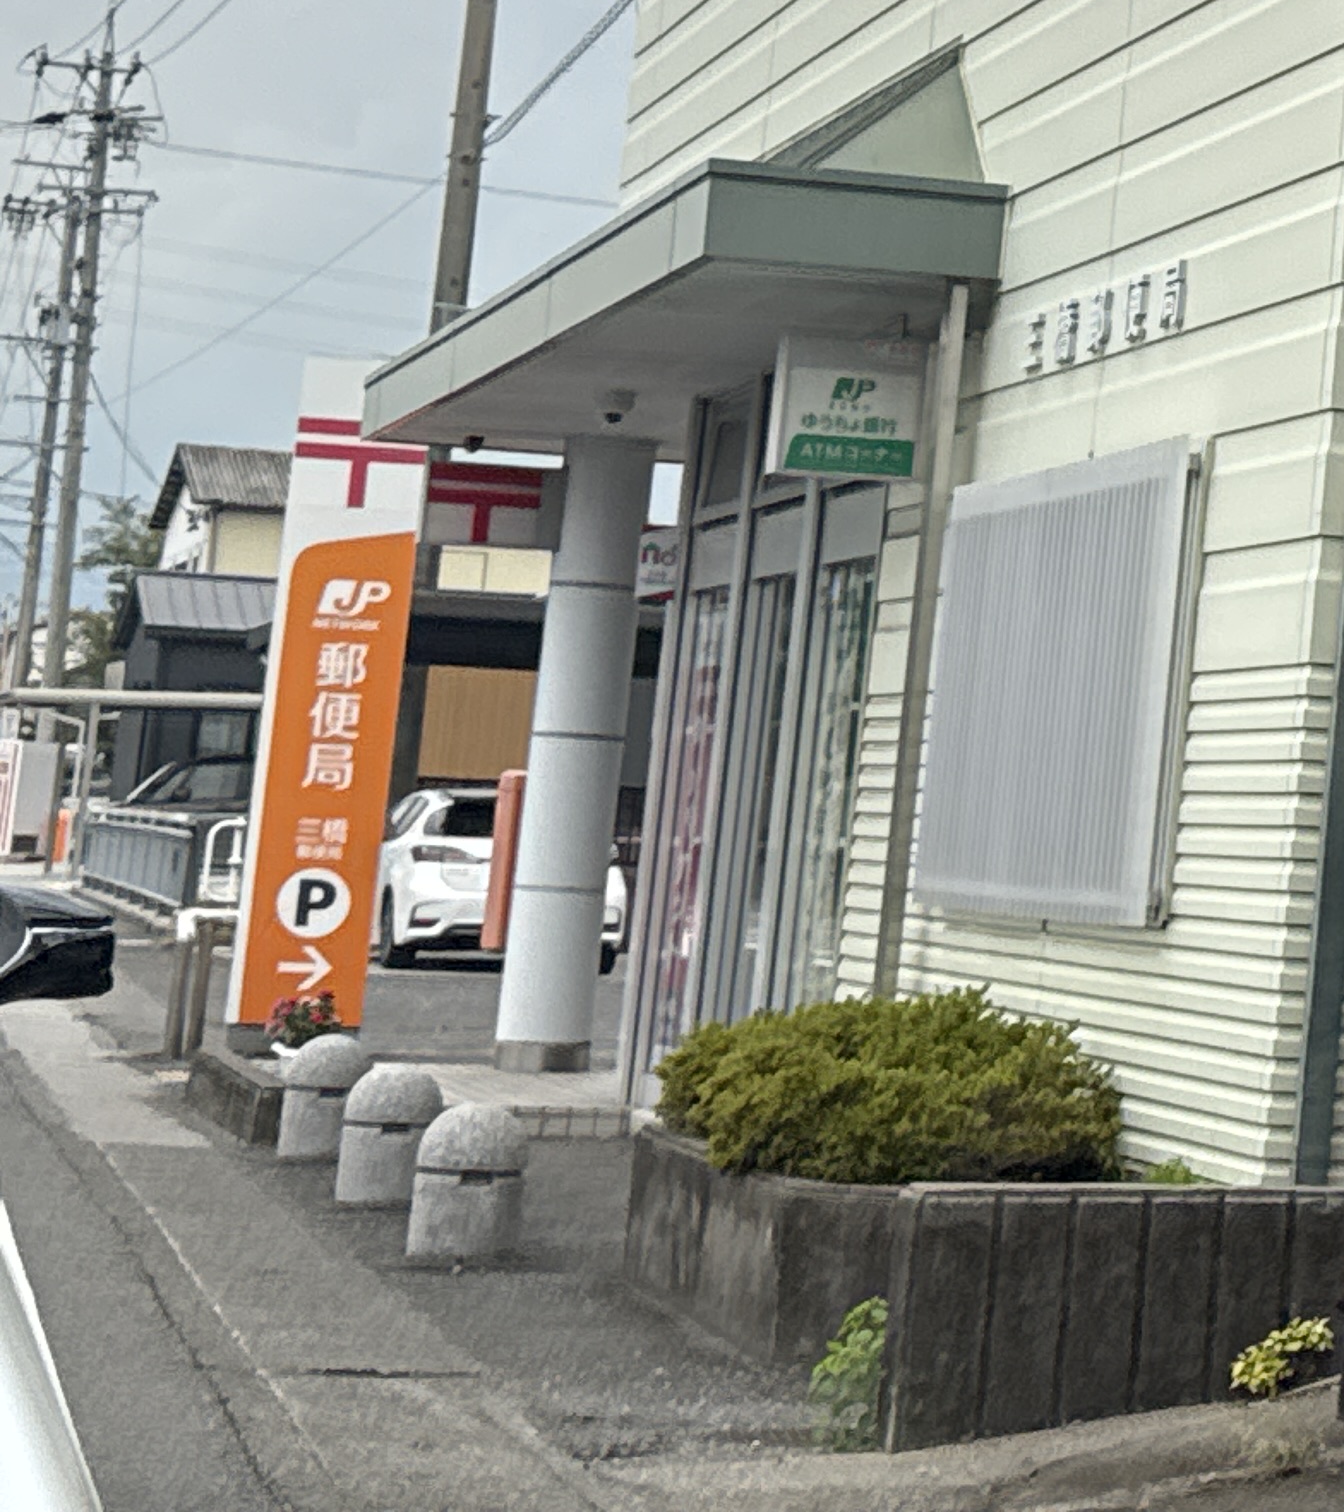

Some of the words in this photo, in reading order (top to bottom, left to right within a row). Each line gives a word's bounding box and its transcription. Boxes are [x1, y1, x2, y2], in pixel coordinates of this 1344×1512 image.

[831, 376, 877, 402] JP
[801, 411, 899, 437] ゆうちょ銀行
[316, 578, 392, 618] JP
[301, 641, 370, 792] 郵便局
[294, 877, 338, 928] P
